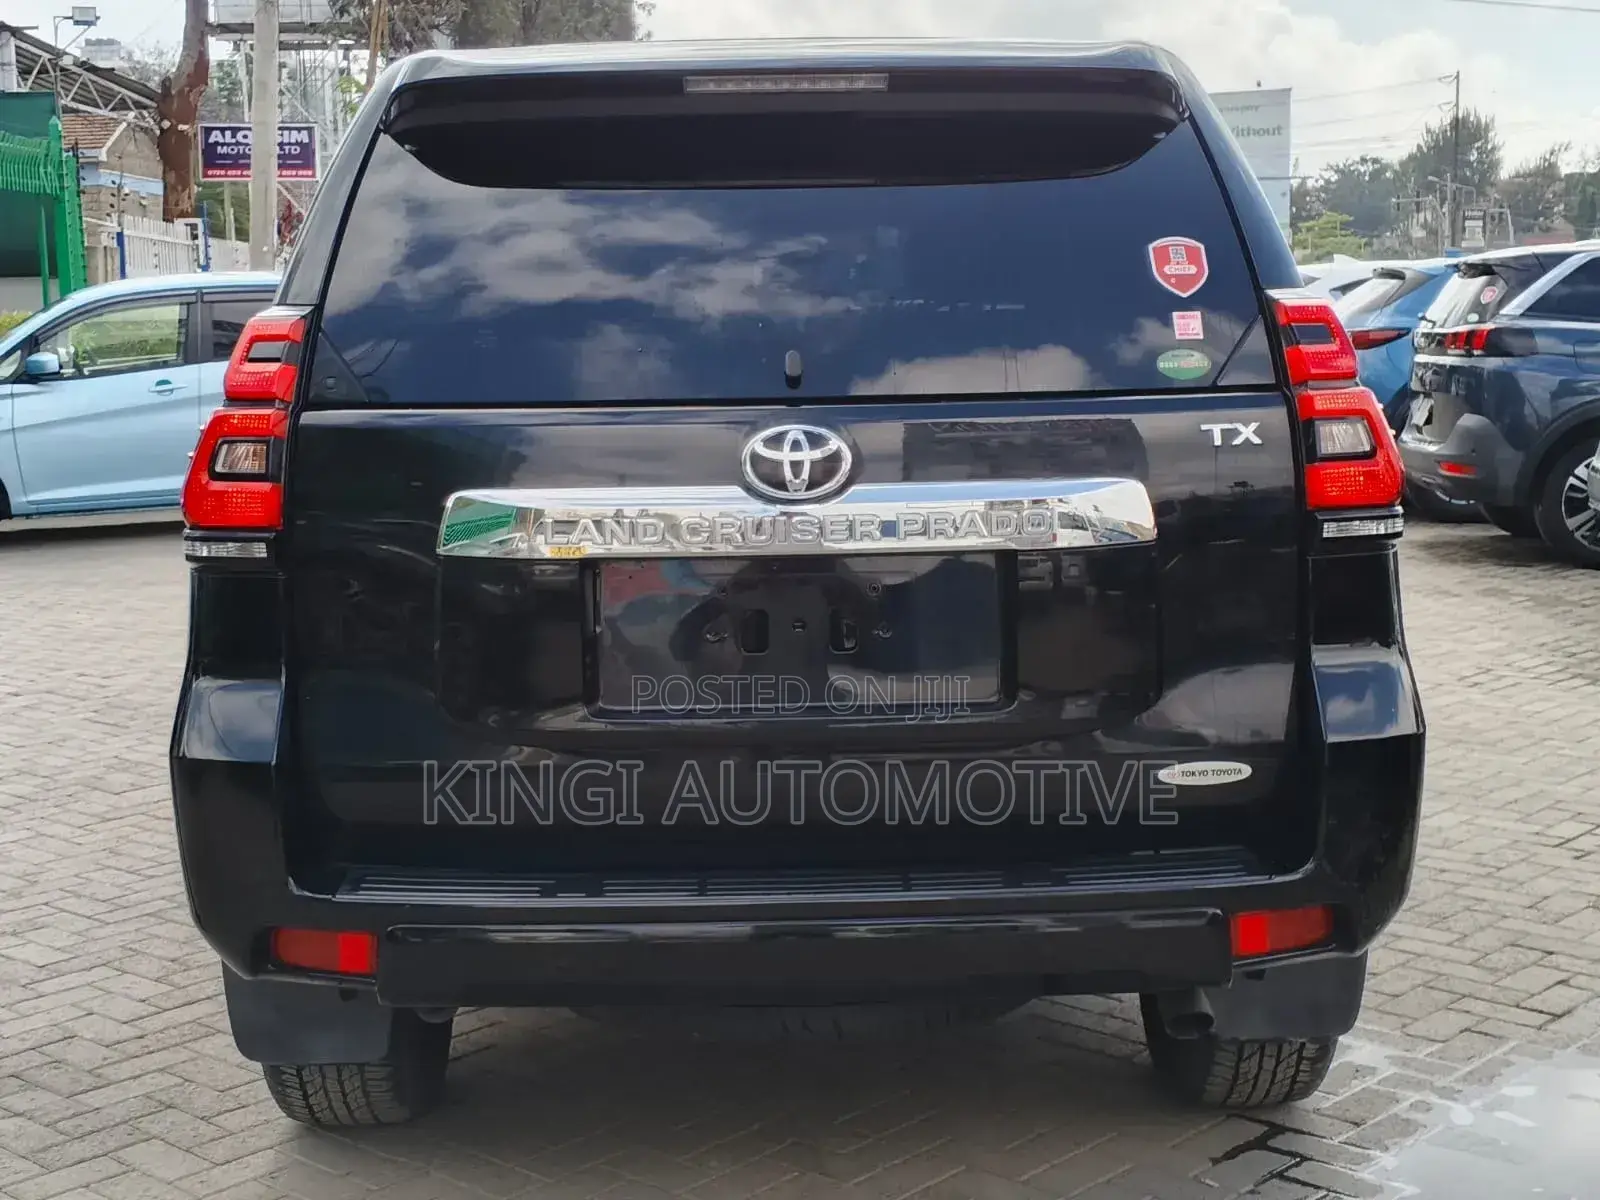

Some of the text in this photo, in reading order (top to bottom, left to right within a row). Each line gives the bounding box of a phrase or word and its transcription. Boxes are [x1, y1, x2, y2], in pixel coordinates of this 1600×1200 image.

[1200, 422, 1263, 446] TX
[544, 511, 1055, 546] LAND CRUISER PRADO
[1181, 767, 1242, 778] TOKYO TOYOTA
